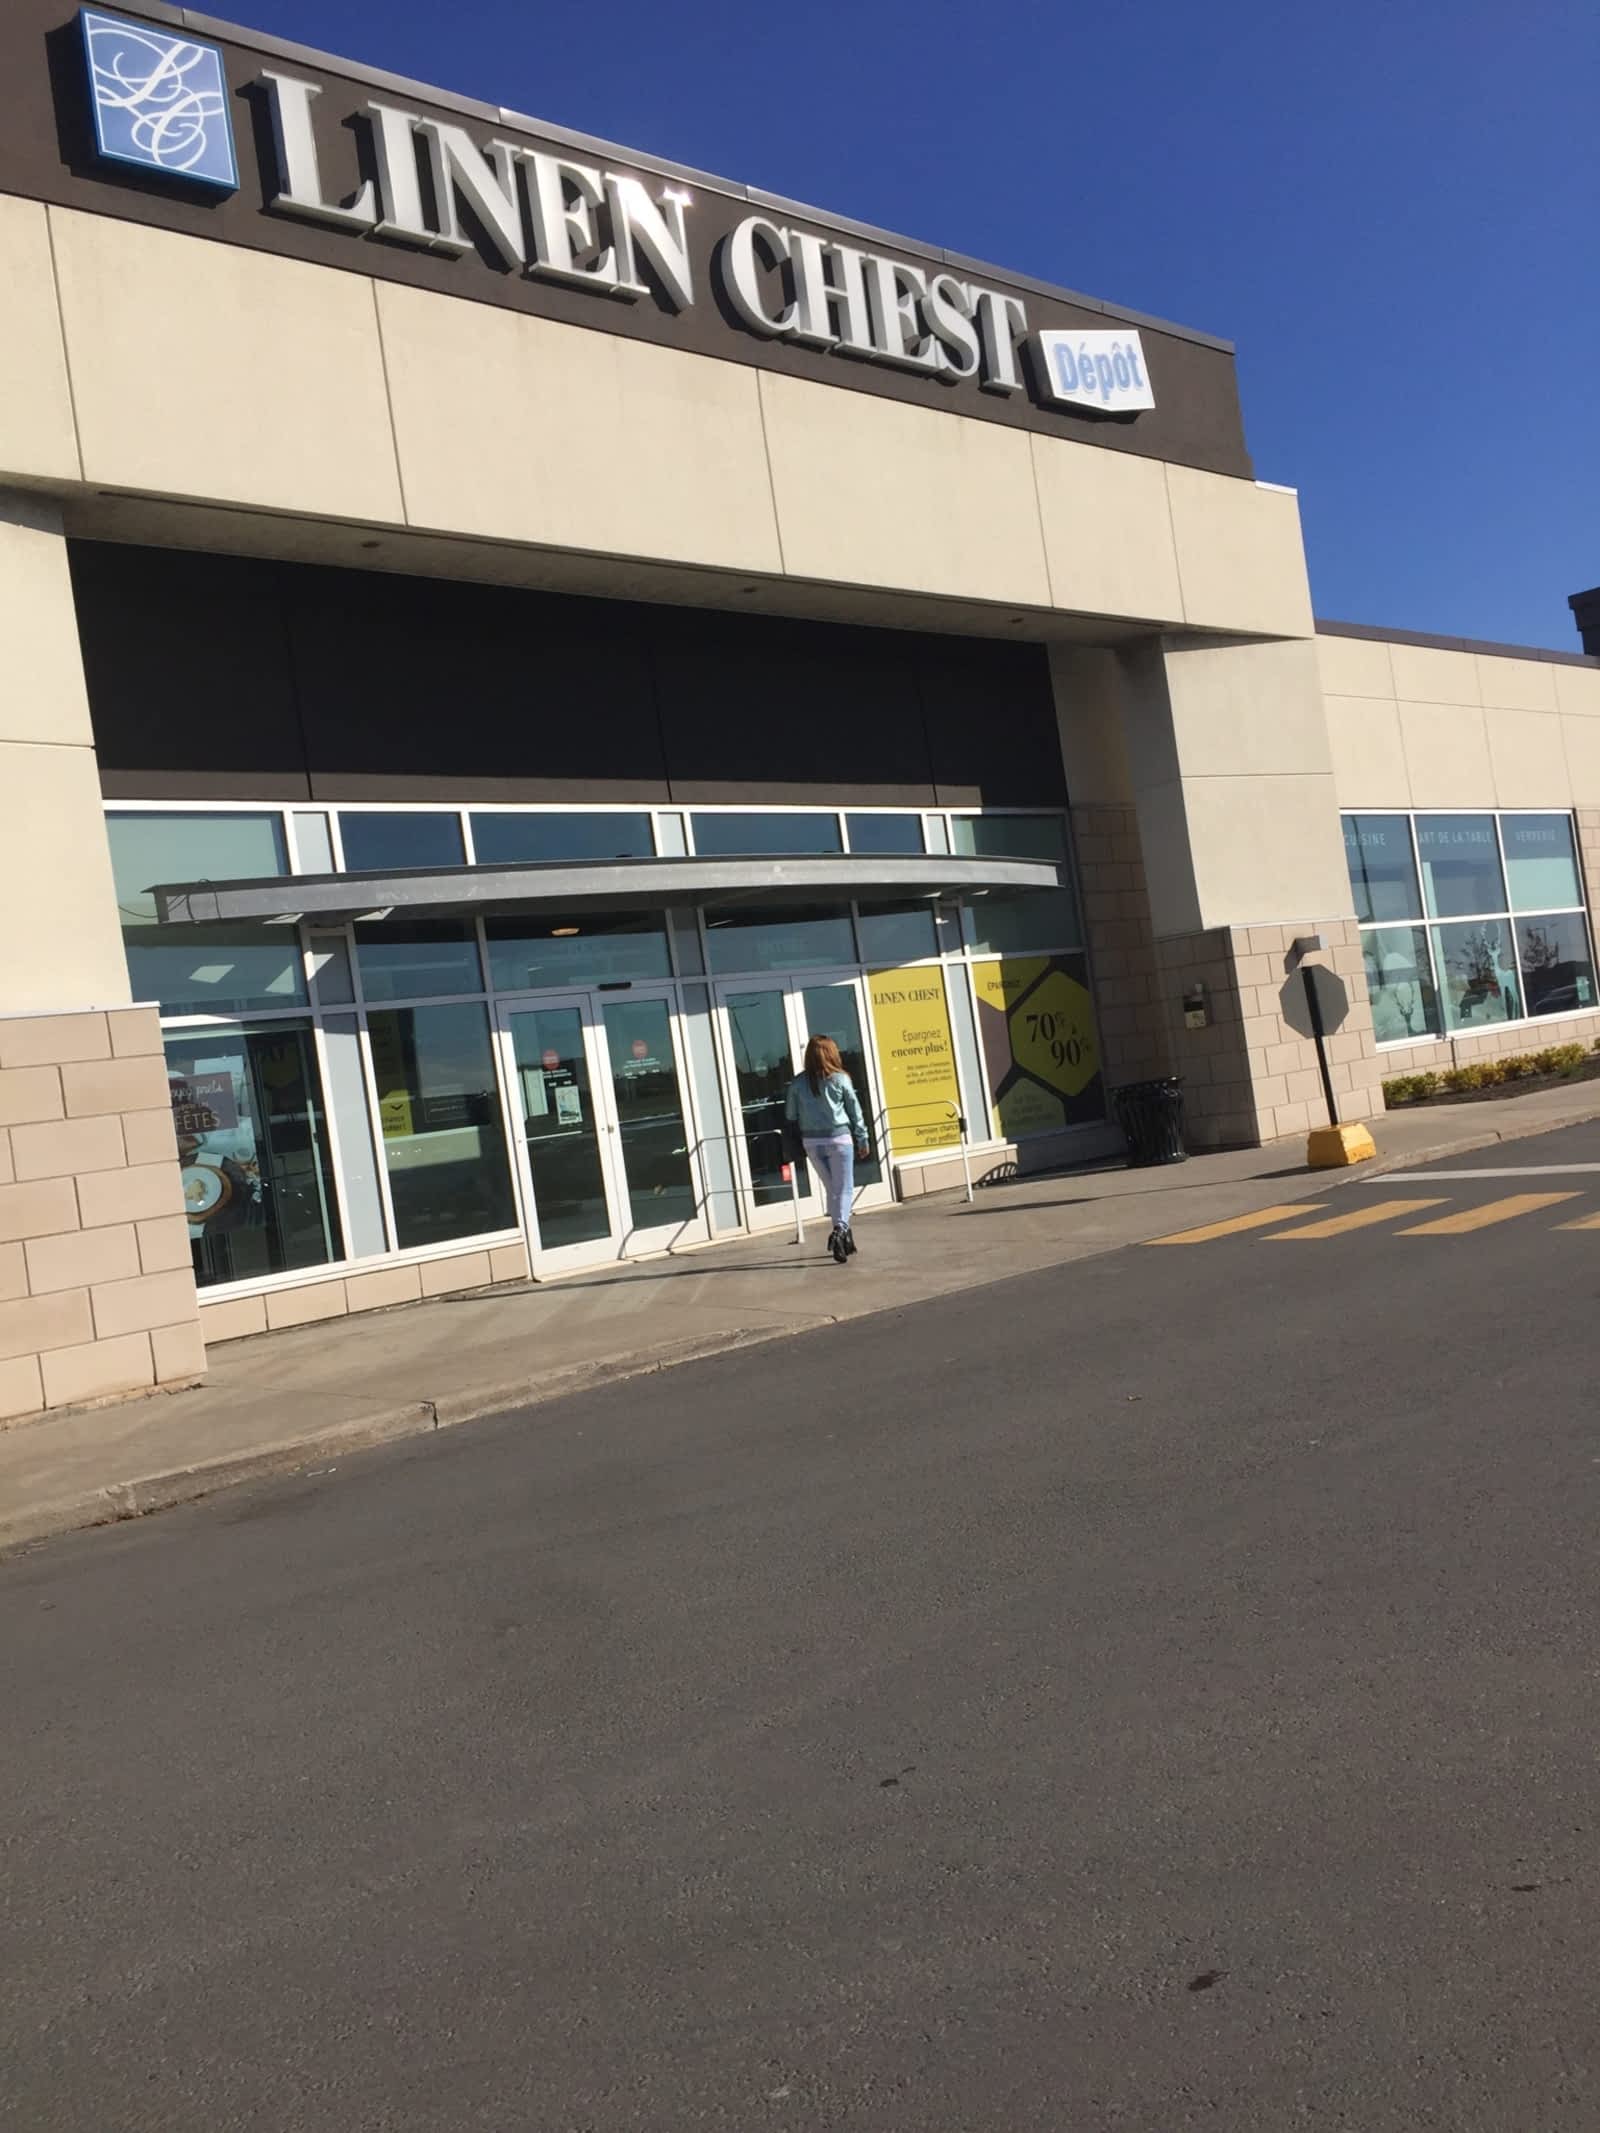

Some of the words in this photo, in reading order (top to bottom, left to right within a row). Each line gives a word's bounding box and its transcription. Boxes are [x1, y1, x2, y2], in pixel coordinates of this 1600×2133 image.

[258, 69, 695, 305] LINEN
[722, 215, 1028, 394] CHEST
[1053, 341, 1144, 402] Dépôt
[874, 991, 906, 1005] LINEN
[908, 988, 940, 1002] CHEST
[891, 1046, 924, 1057] encore
[925, 1040, 949, 1056] plus!
